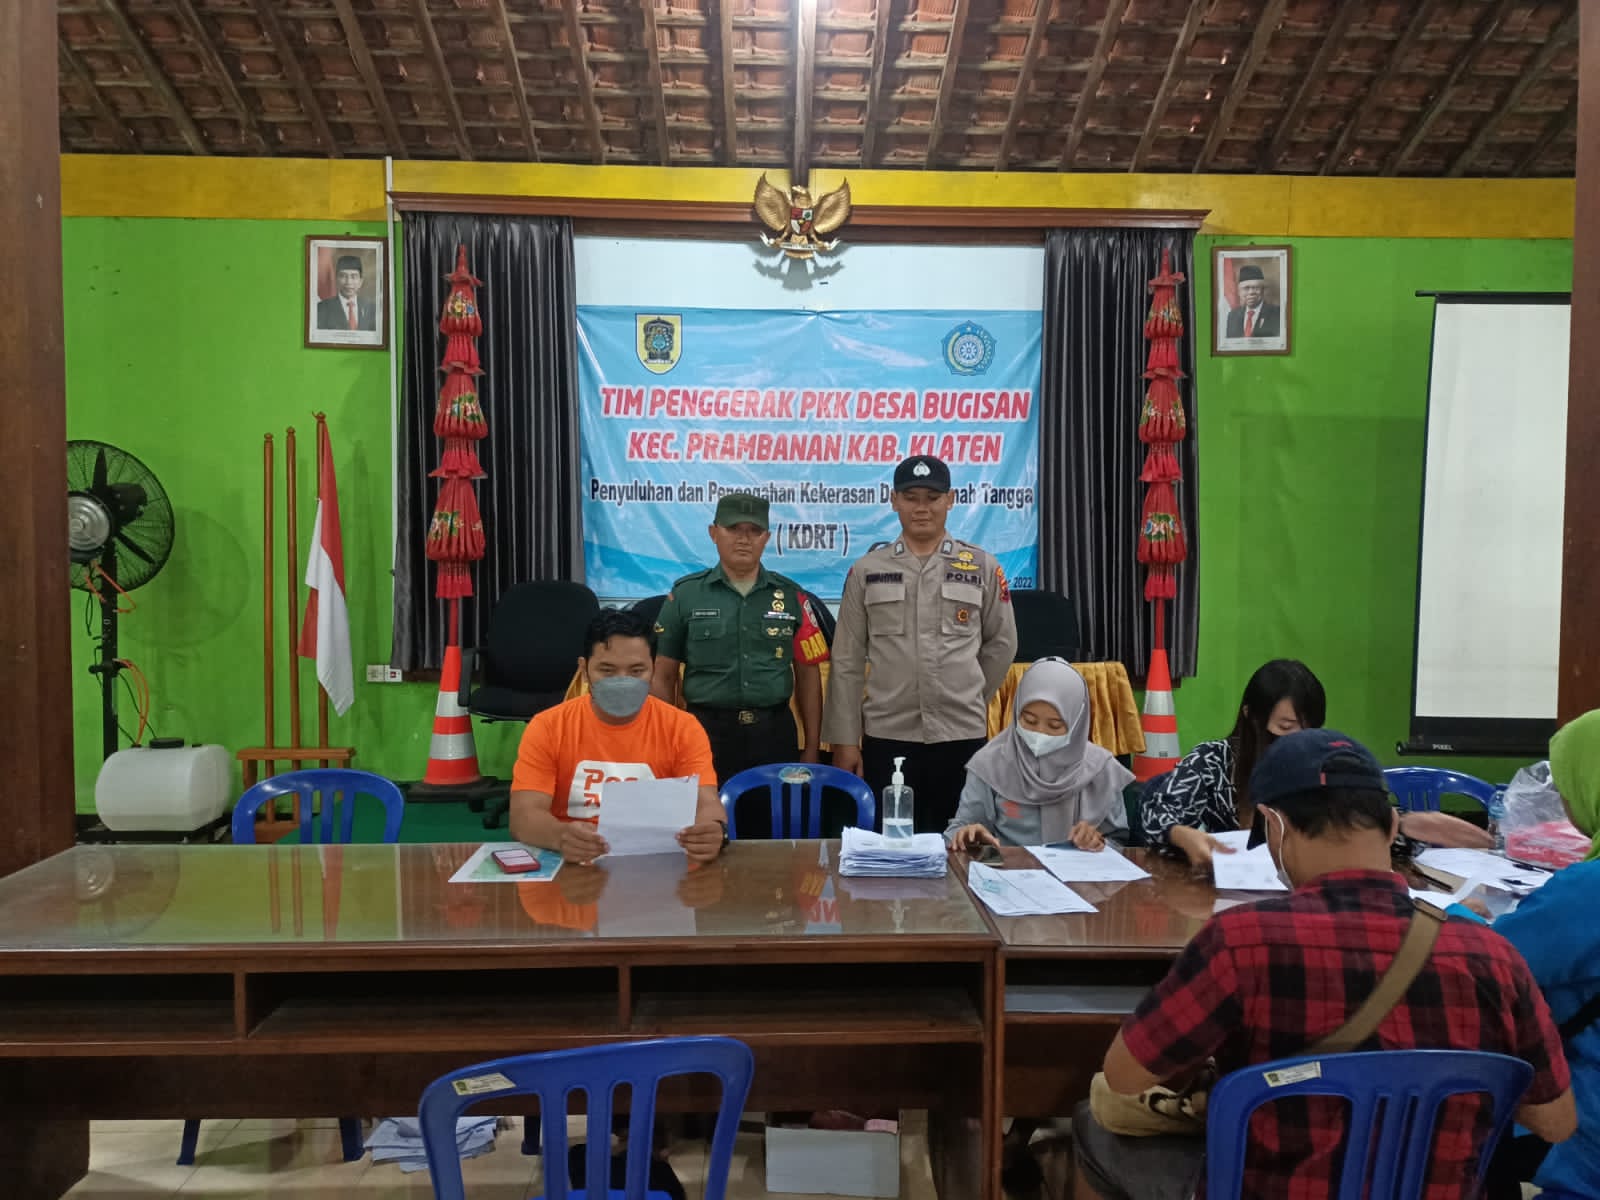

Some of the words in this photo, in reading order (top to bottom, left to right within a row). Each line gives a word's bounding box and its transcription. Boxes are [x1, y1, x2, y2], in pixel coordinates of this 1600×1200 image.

[602, 386, 642, 416] TIM
[648, 388, 793, 419] PENGGERAK
[799, 390, 850, 420] PKK
[857, 391, 916, 420] DESA
[923, 391, 1030, 420] BUGISAN
[628, 431, 679, 460] KEC.
[686, 432, 841, 462] PRAMBANAN
[847, 434, 903, 462] KAB.
[590, 478, 672, 506] Penyuluhan
[678, 481, 704, 503] dan
[800, 481, 876, 505] Kekerasan
[981, 482, 1033, 509] Tangga
[946, 572, 982, 585] POLRI
[1013, 576, 1032, 588] 2022
